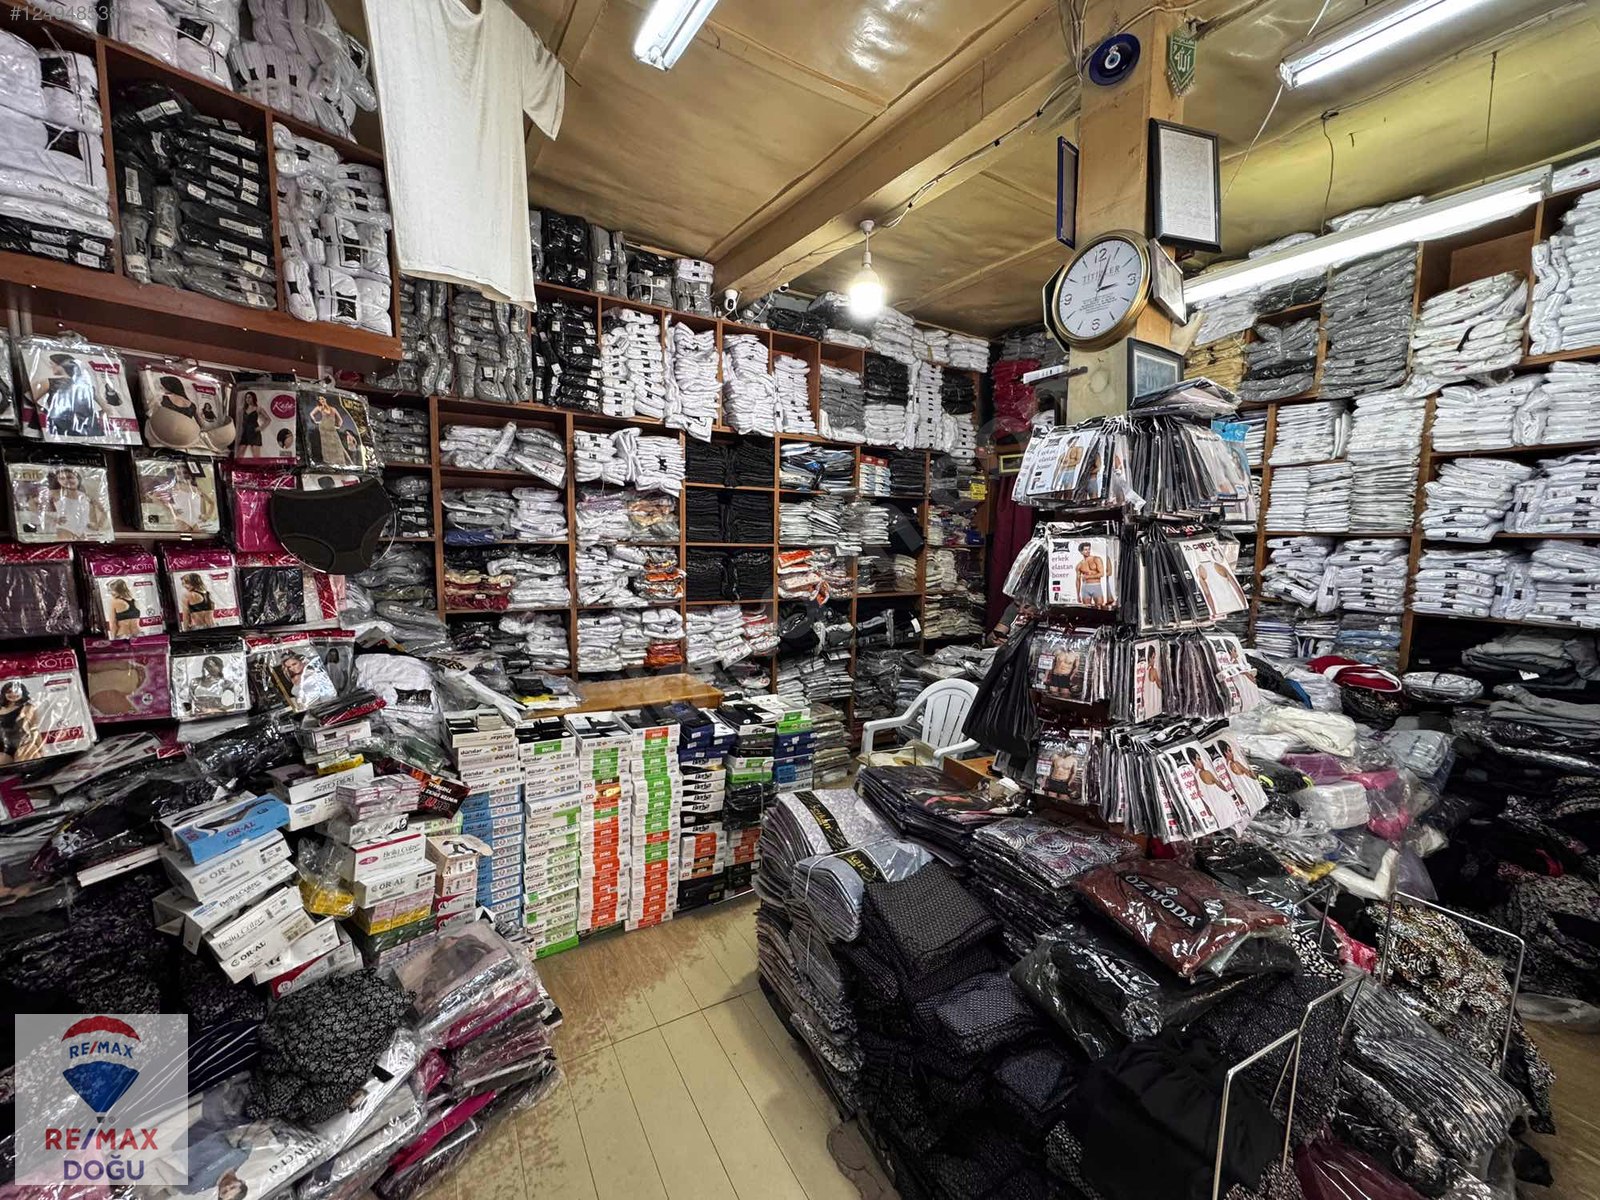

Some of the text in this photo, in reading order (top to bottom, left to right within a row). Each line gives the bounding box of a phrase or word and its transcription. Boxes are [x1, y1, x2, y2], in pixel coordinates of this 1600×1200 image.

[1094, 248, 1108, 264] 12
[1127, 273, 1137, 286] 3
[1064, 293, 1073, 306] 9
[1146, 889, 1196, 927] MODA
